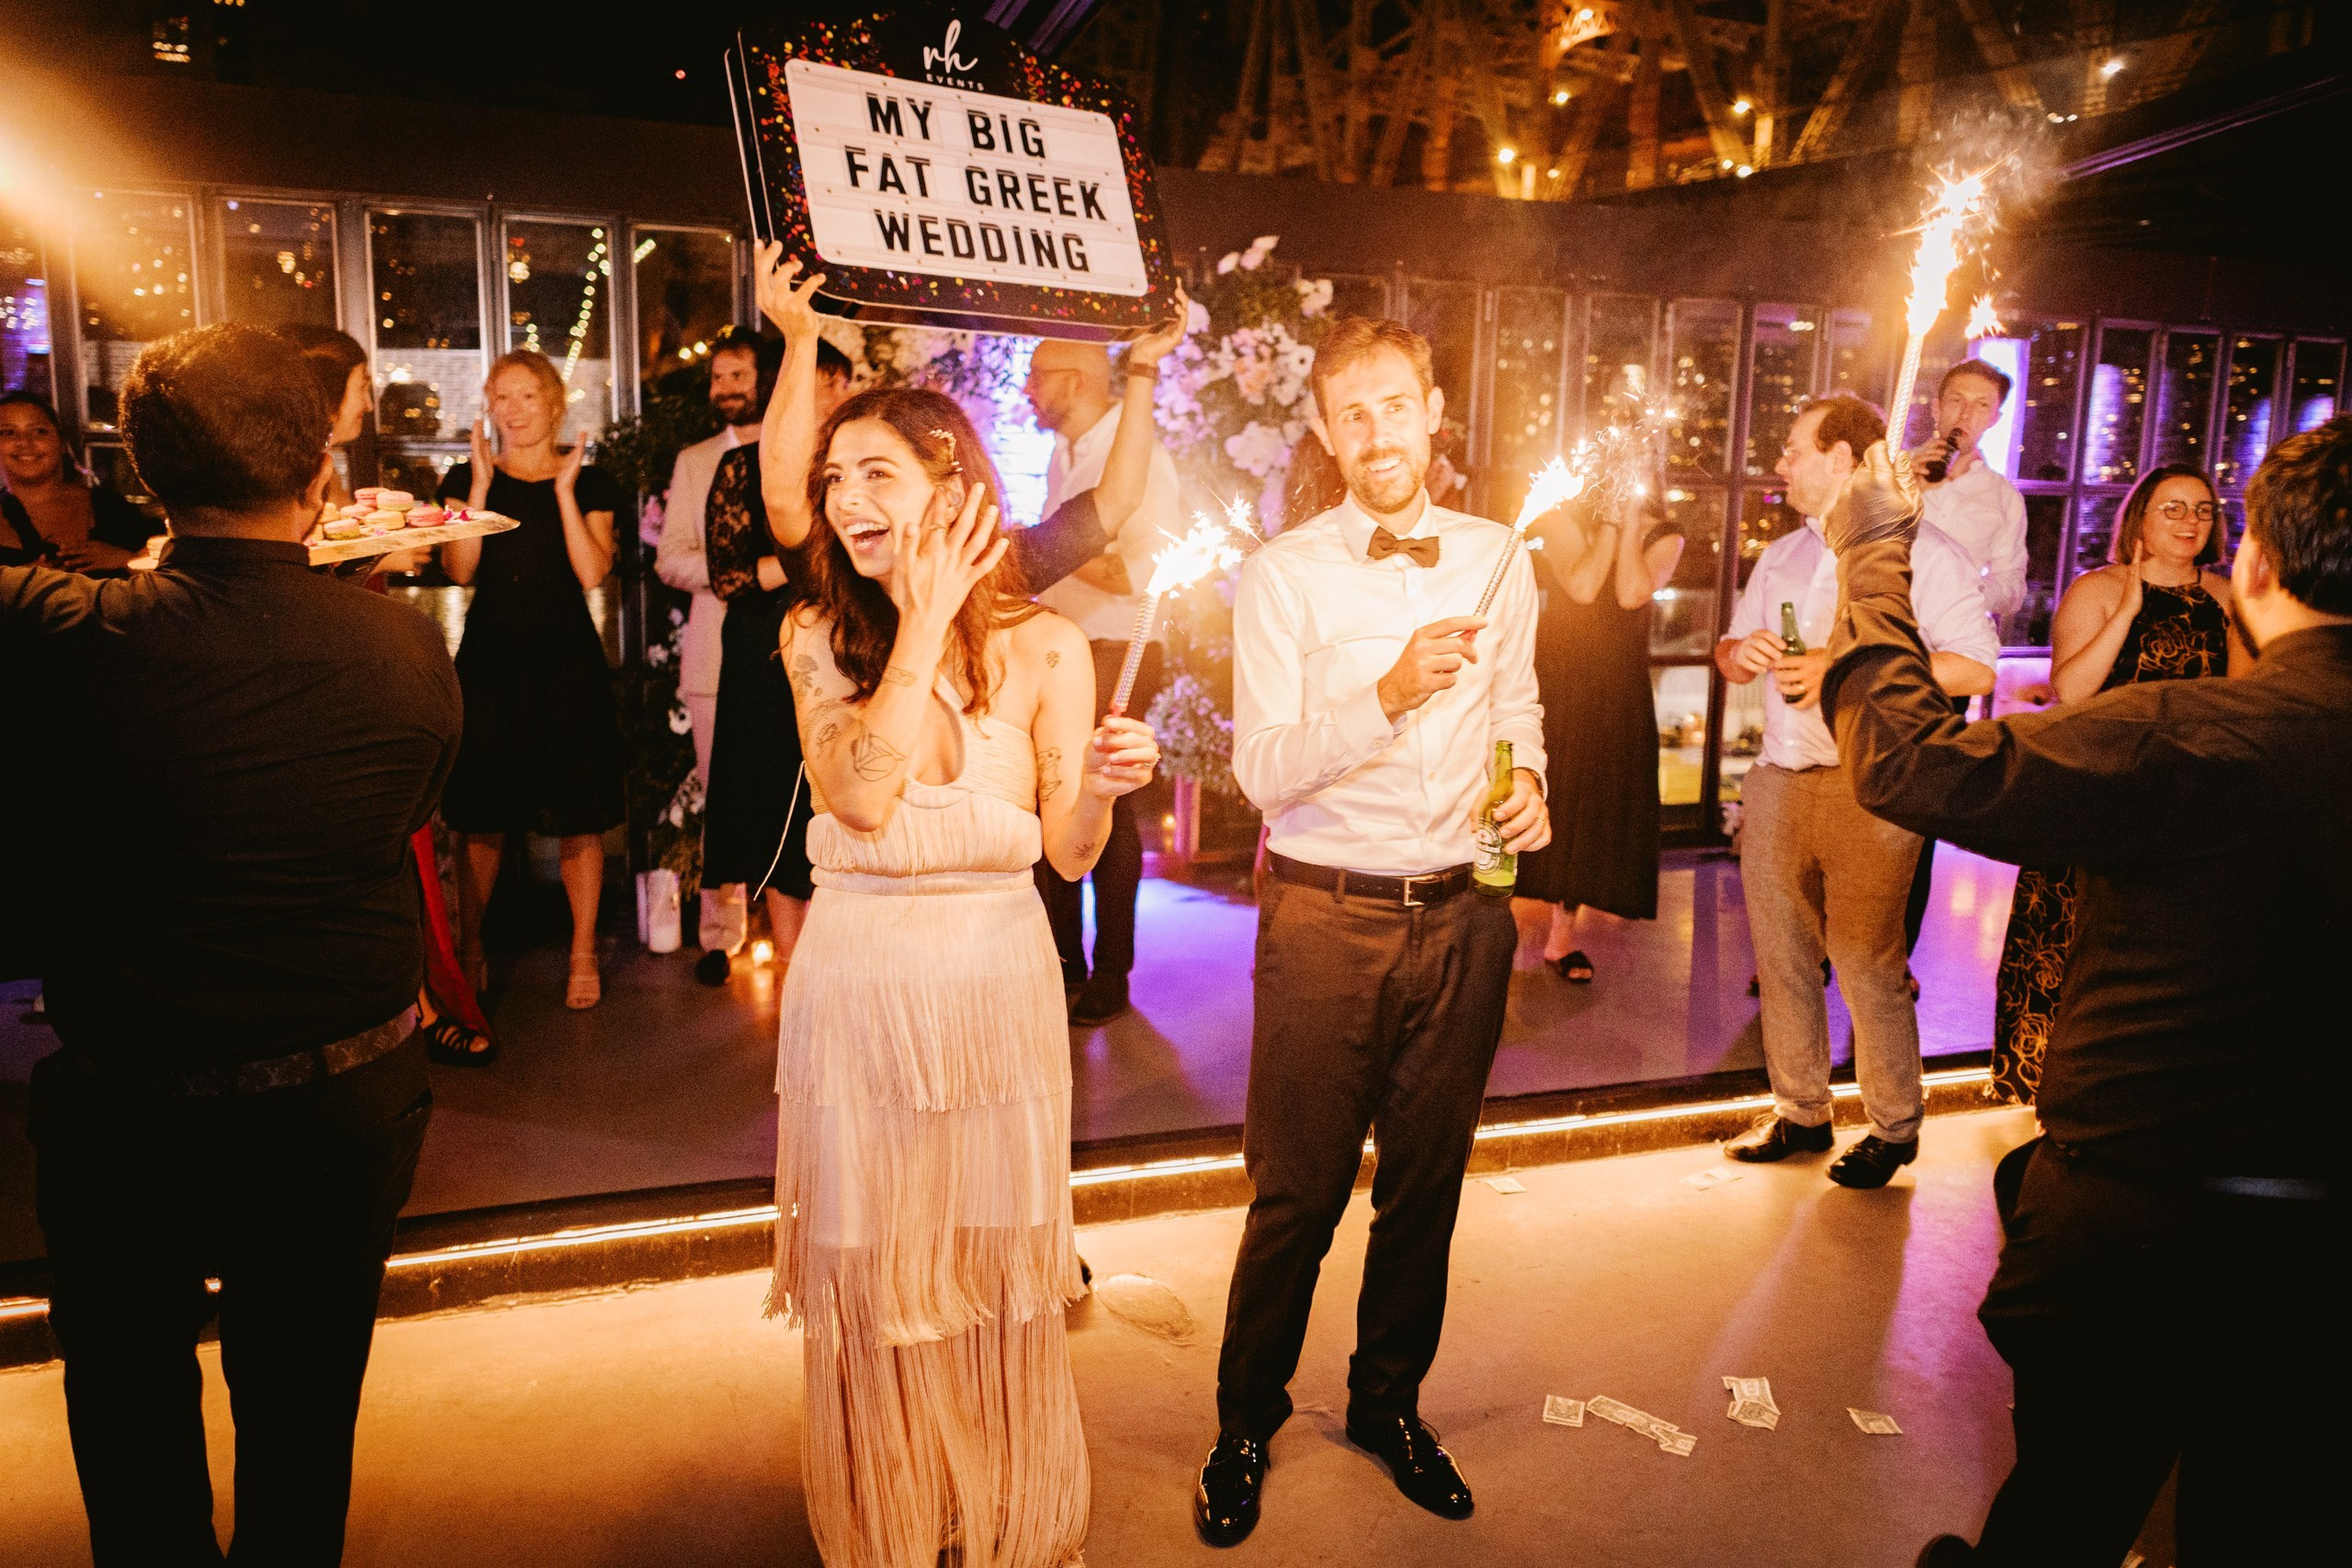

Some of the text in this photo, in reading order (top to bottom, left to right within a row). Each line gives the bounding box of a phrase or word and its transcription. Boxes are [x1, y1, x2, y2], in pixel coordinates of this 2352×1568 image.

[923, 19, 978, 73] rh
[926, 73, 984, 91] EVENTS
[866, 93, 1046, 159] MY BIG
[844, 145, 1107, 220] FAT GREEK
[874, 209, 1089, 273] WEDDING
